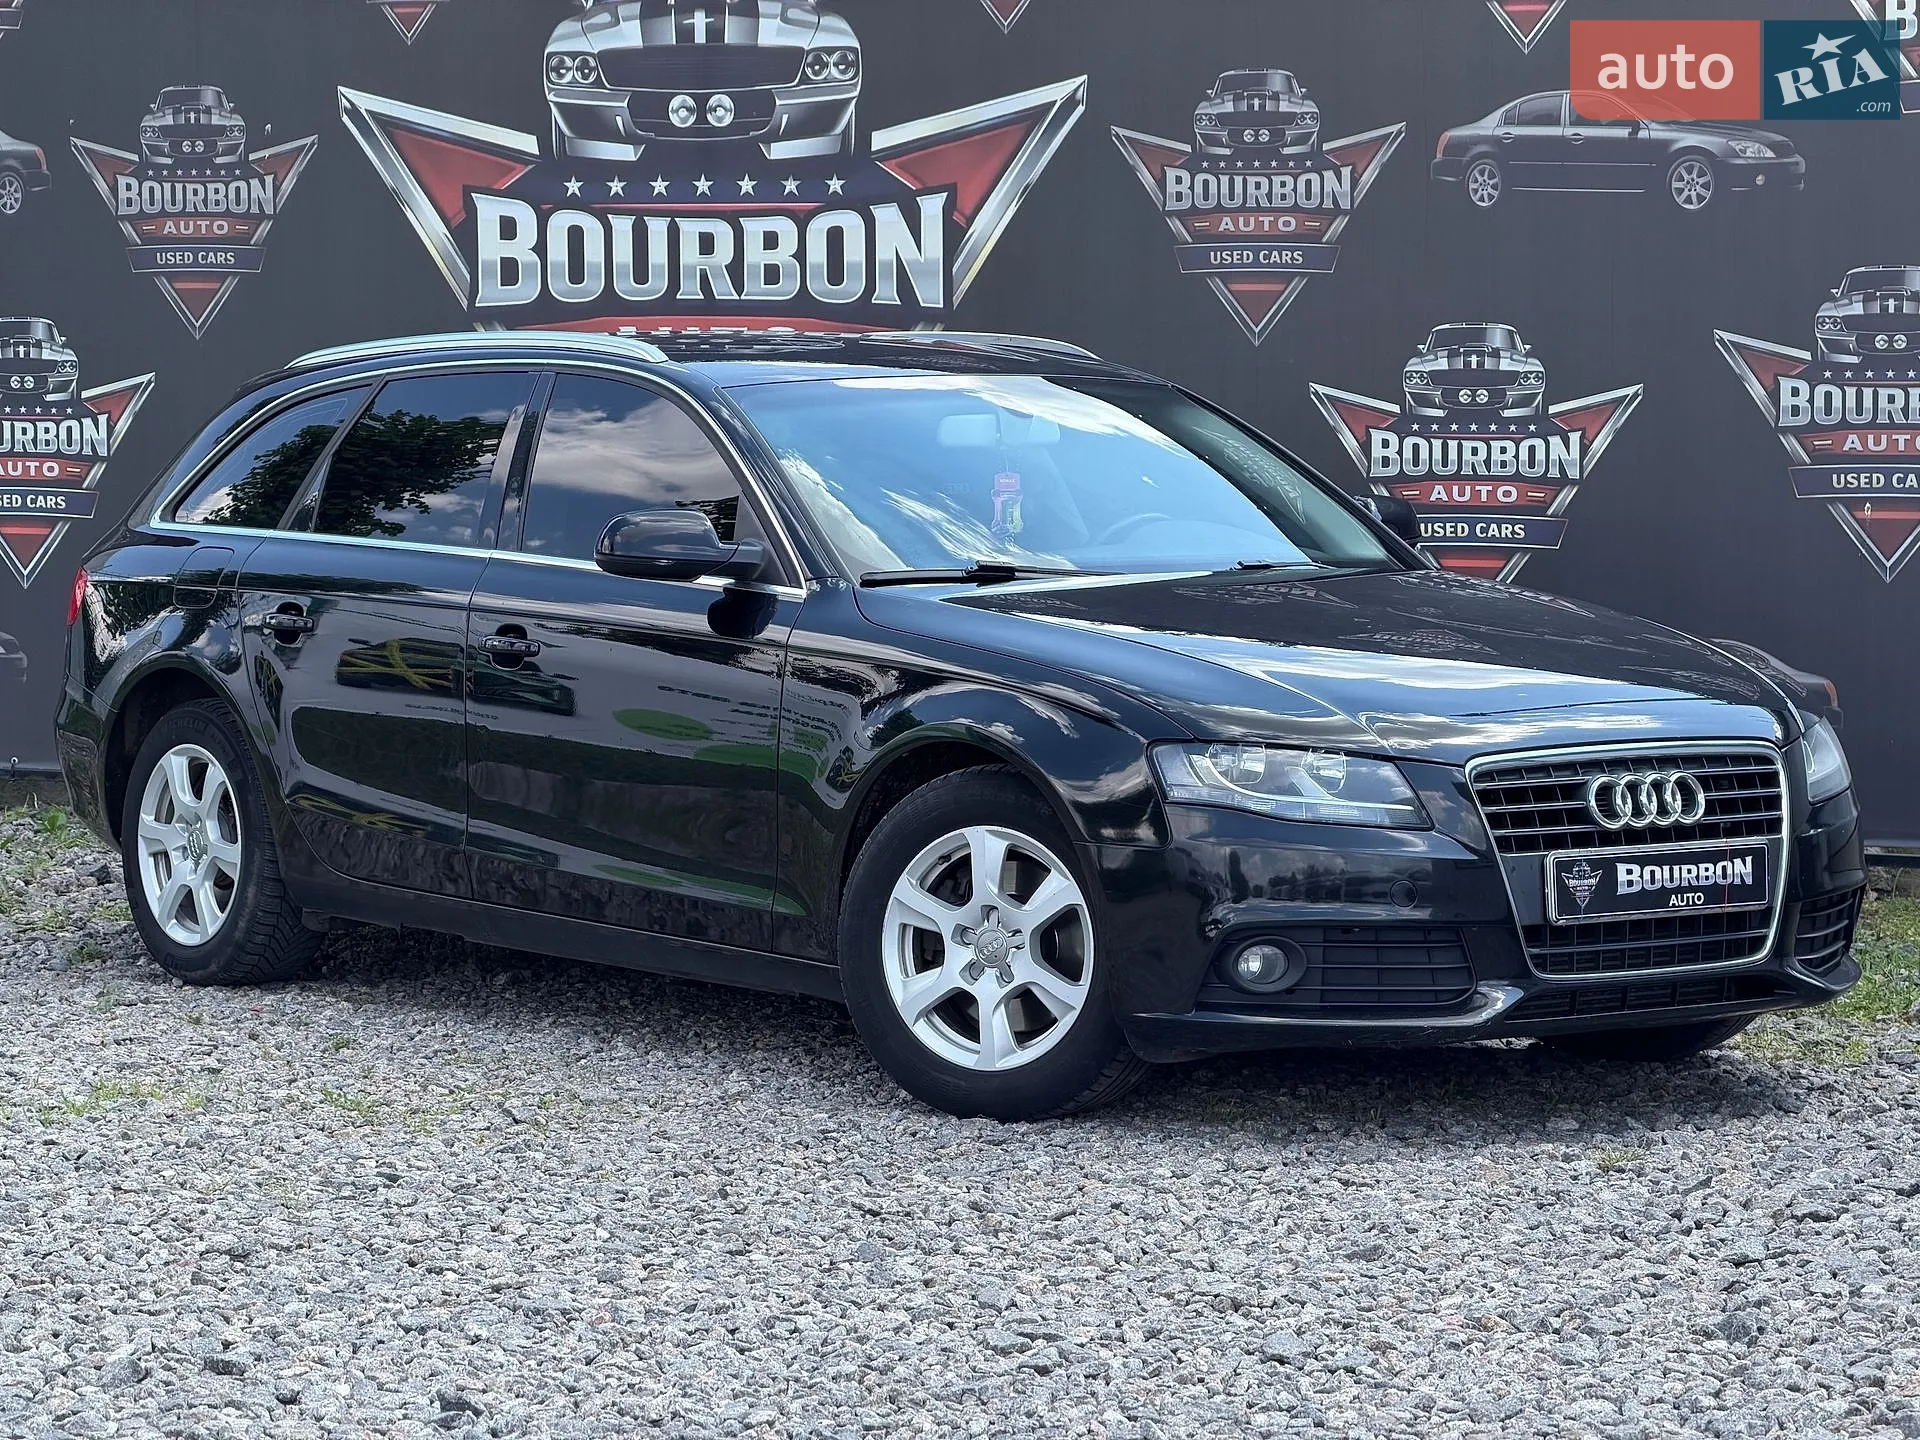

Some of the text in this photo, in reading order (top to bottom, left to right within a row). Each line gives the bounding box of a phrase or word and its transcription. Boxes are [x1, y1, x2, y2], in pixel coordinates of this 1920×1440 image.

[116, 174, 275, 216] BOURBON
[1164, 165, 1353, 212] BOURBON
[162, 220, 230, 235] AUTO
[1218, 216, 1297, 232] AUTO
[471, 191, 949, 308] BOURBON
[1209, 249, 1304, 265] USED CARS
[156, 251, 236, 265] USED CARS
[1842, 433, 1920, 452] AUT
[1368, 428, 1583, 480] BOURBON
[1832, 473, 1886, 489] USED
[0, 494, 67, 509] ED CARS
[1429, 485, 1519, 503] AUTO
[1420, 523, 1526, 539] USED CARS
[1615, 855, 1753, 896] BOURBON
[1668, 892, 1705, 907] AUTO
